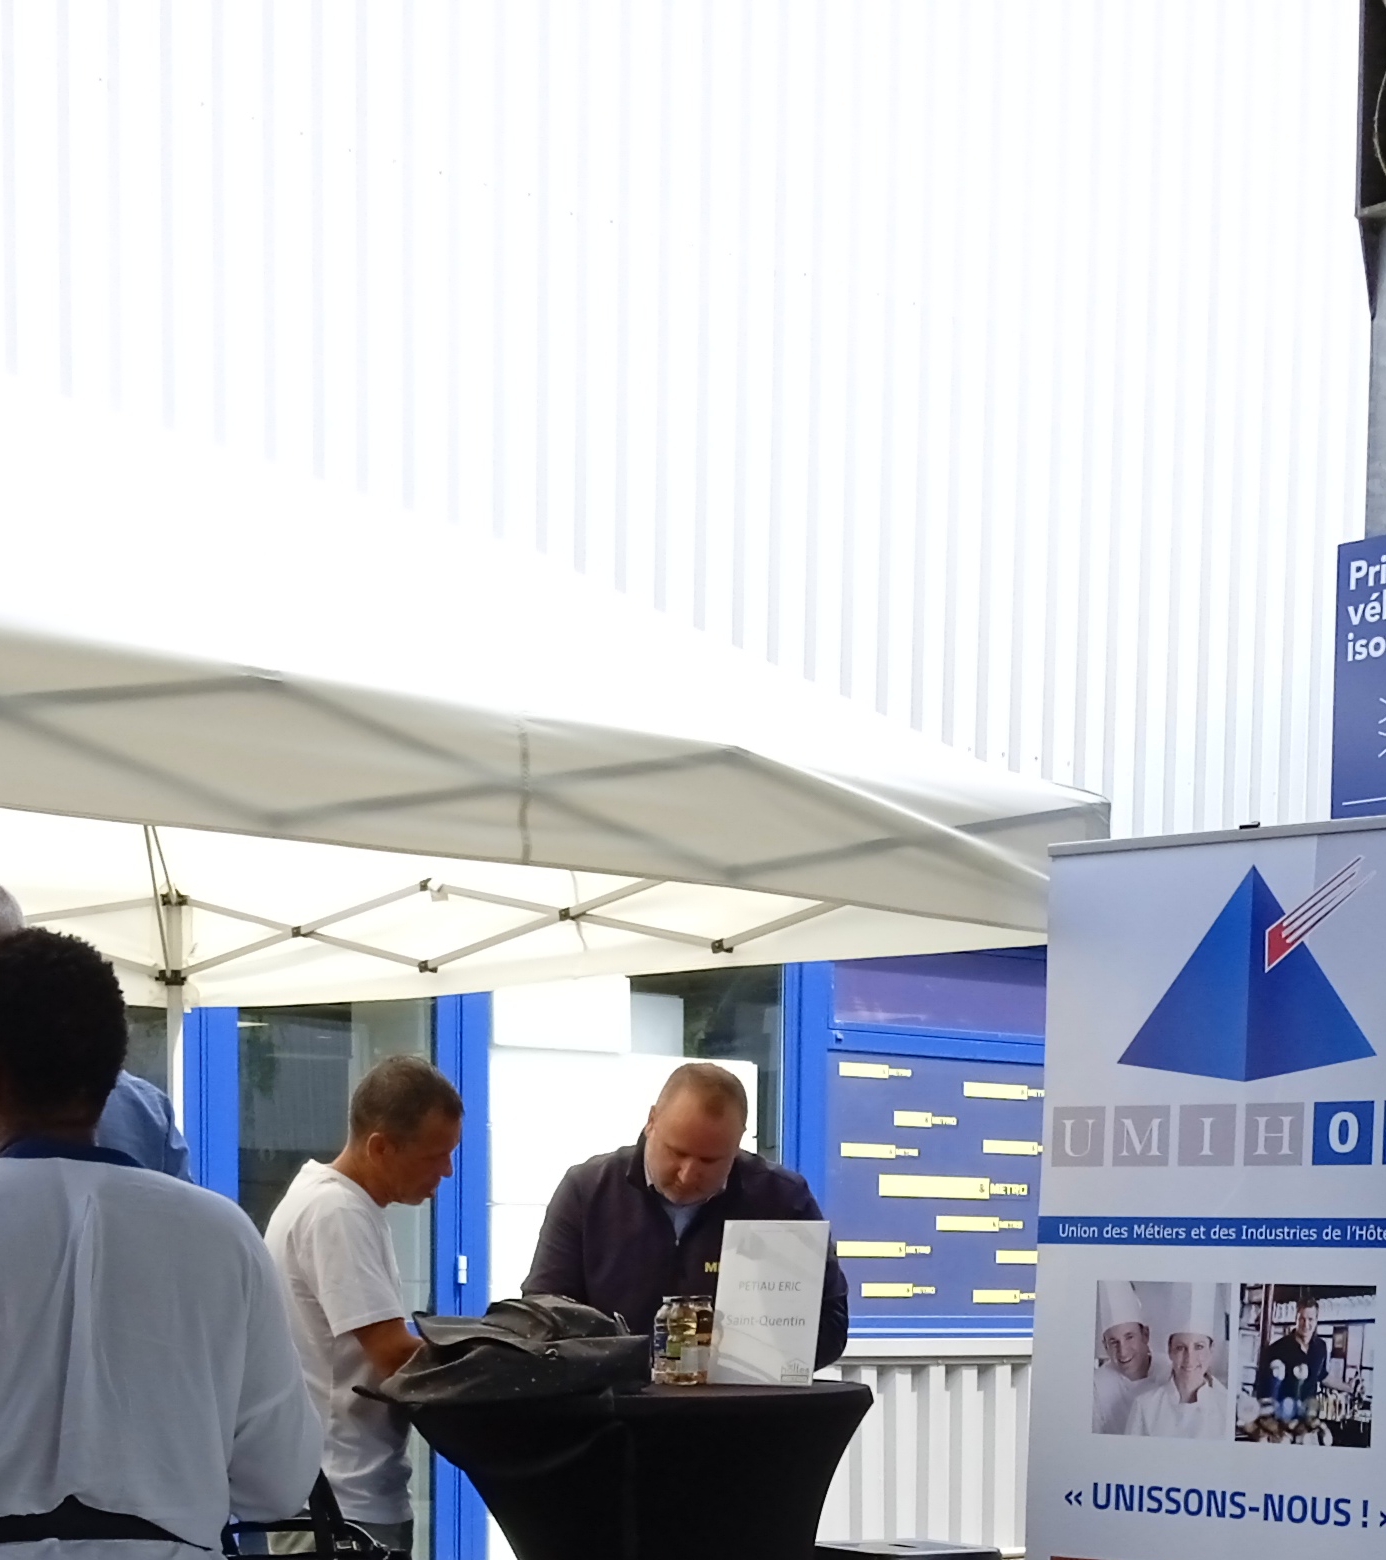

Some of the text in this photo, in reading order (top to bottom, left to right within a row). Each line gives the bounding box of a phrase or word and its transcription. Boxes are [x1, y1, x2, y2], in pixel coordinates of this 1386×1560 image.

[1062, 1115, 1295, 1158] UMIH
[1058, 1223, 1099, 1238] Union
[1102, 1223, 1129, 1239] des
[1133, 1222, 1186, 1239] Métiers
[1190, 1225, 1206, 1240] et
[1210, 1224, 1236, 1240] des
[1241, 1224, 1318, 1240] Industries
[1322, 1225, 1342, 1241] de
[778, 1281, 802, 1292] ERIC
[725, 1314, 806, 1327] Saint-Quentin
[1092, 1482, 1351, 1528] UNISSONS-NOUS
